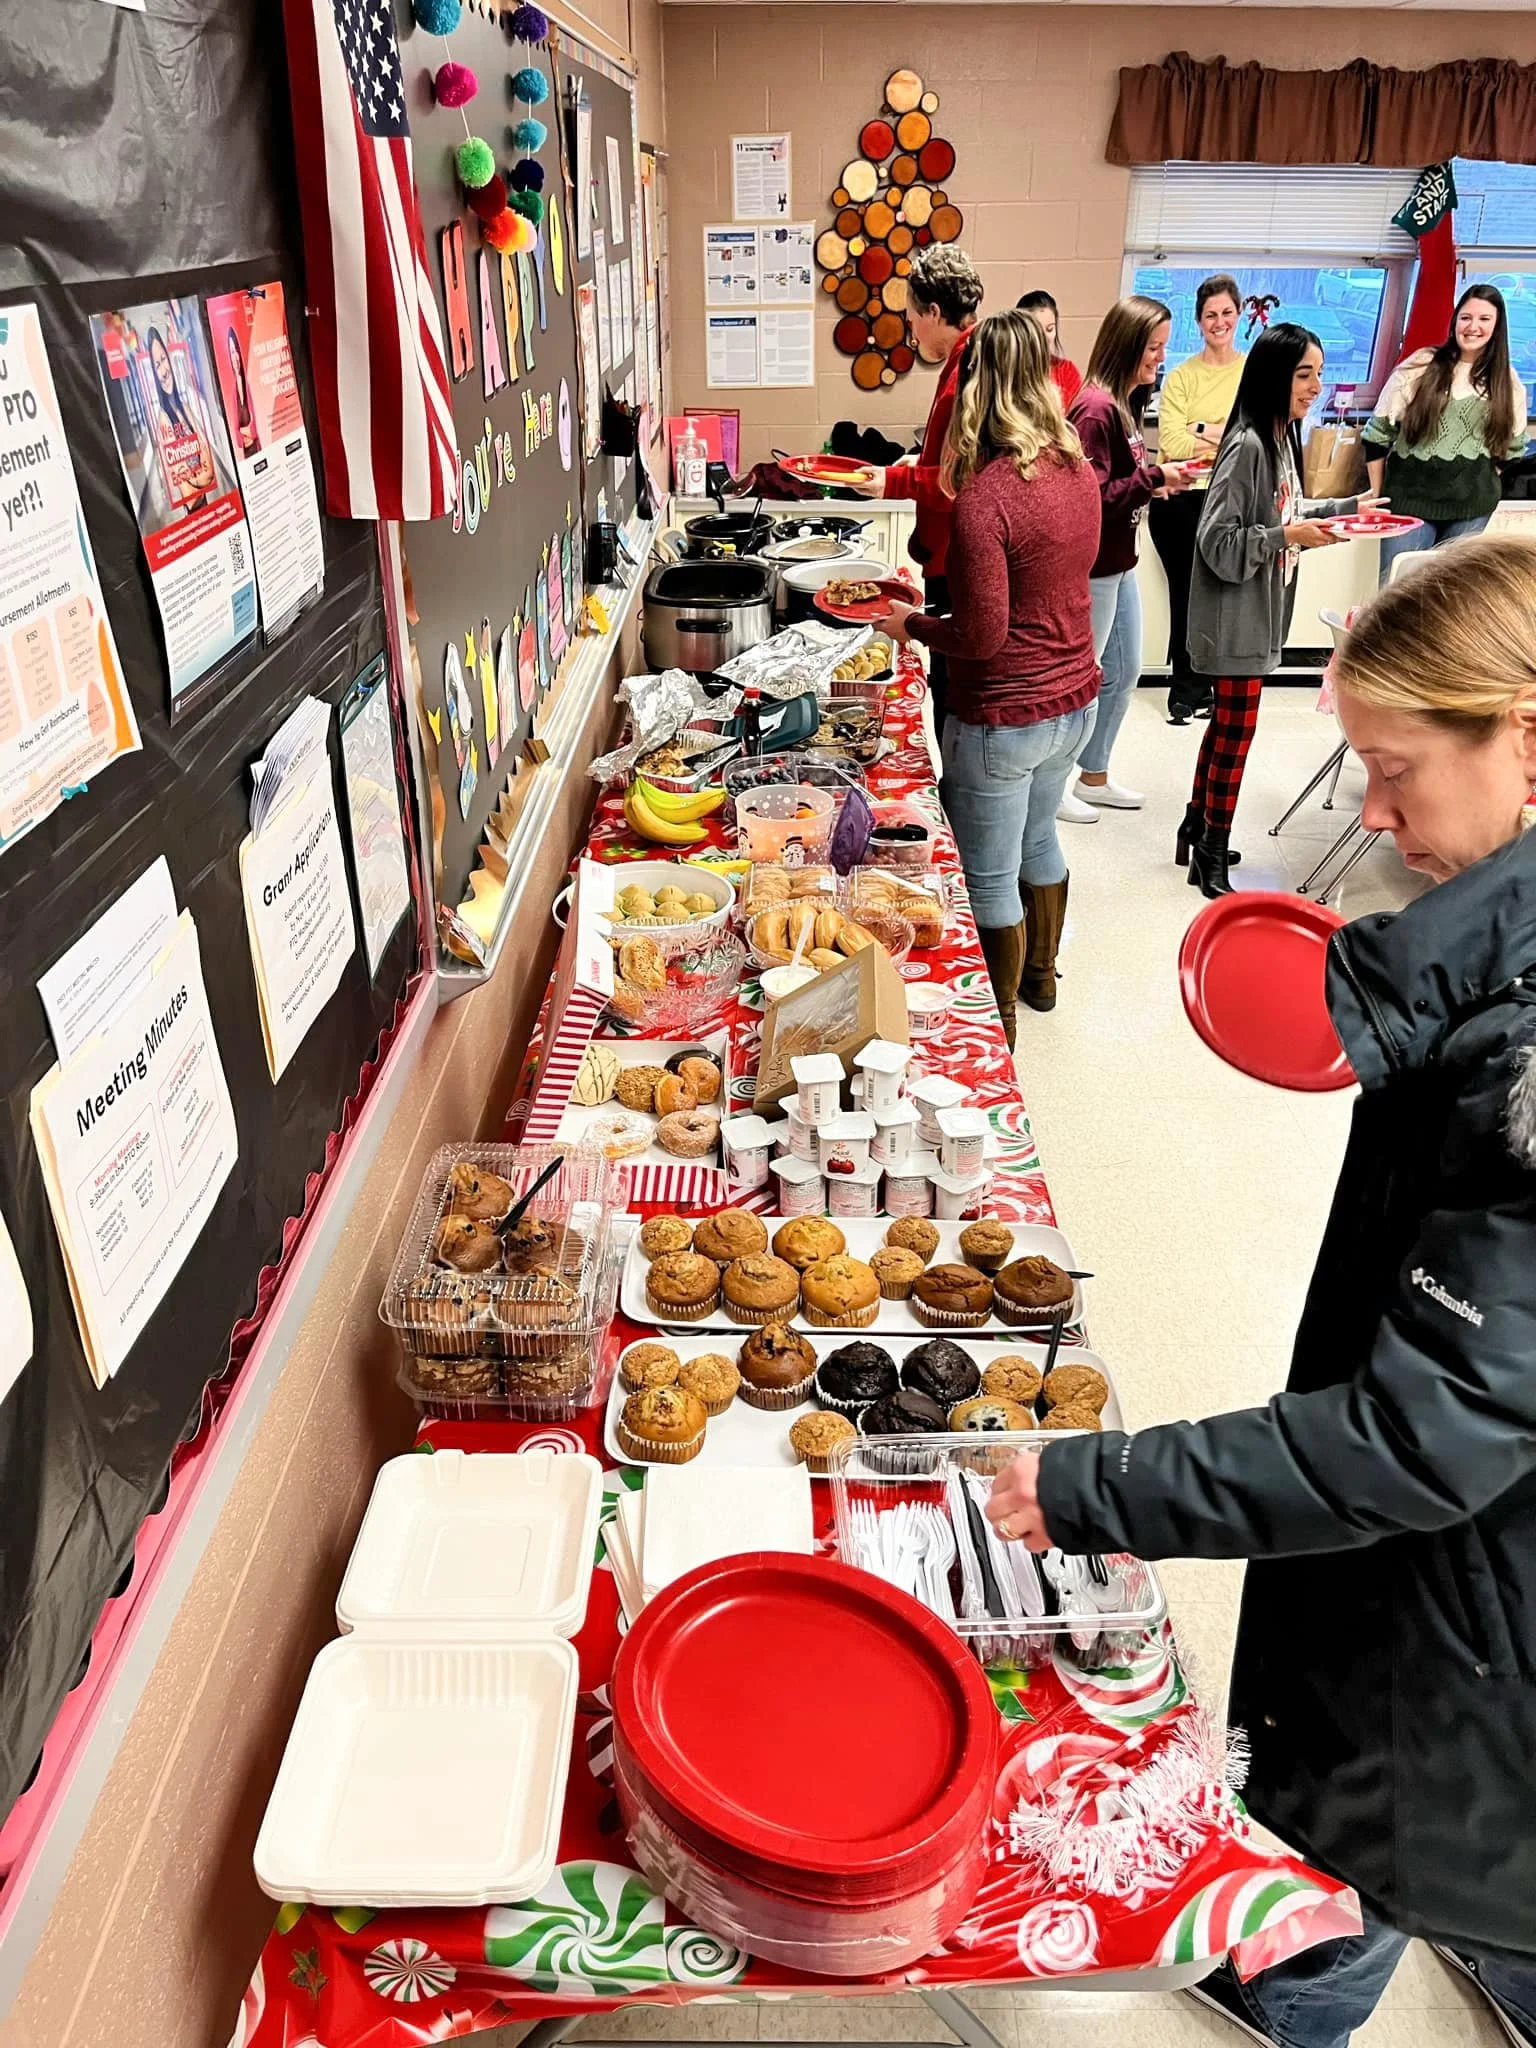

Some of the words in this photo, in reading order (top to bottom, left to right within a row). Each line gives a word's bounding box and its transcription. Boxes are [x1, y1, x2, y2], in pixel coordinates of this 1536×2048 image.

[1413, 188, 1450, 226] STAFF
[1416, 178, 1446, 208] AND
[3, 389, 38, 426] PTO
[161, 425, 173, 440] We
[165, 440, 200, 465] Christian
[2, 480, 44, 532] yet?!
[36, 582, 71, 609] Allotments
[19, 736, 34, 752] How
[35, 732, 42, 743] to
[42, 723, 51, 740] Get
[51, 703, 81, 733] Reimbursed
[262, 862, 293, 908] Grant
[294, 809, 332, 876] Applications
[76, 1044, 149, 1137] Meeting
[144, 984, 189, 1056] Minutes
[115, 1163, 124, 1177] the
[124, 1148, 135, 1165] PTO
[135, 1132, 150, 1151] Room
[126, 1286, 144, 1315] meeting
[144, 1259, 160, 1286] minutes
[168, 1237, 174, 1247] be
[173, 1218, 185, 1238] found
[1422, 1275, 1484, 1328] Columbia
